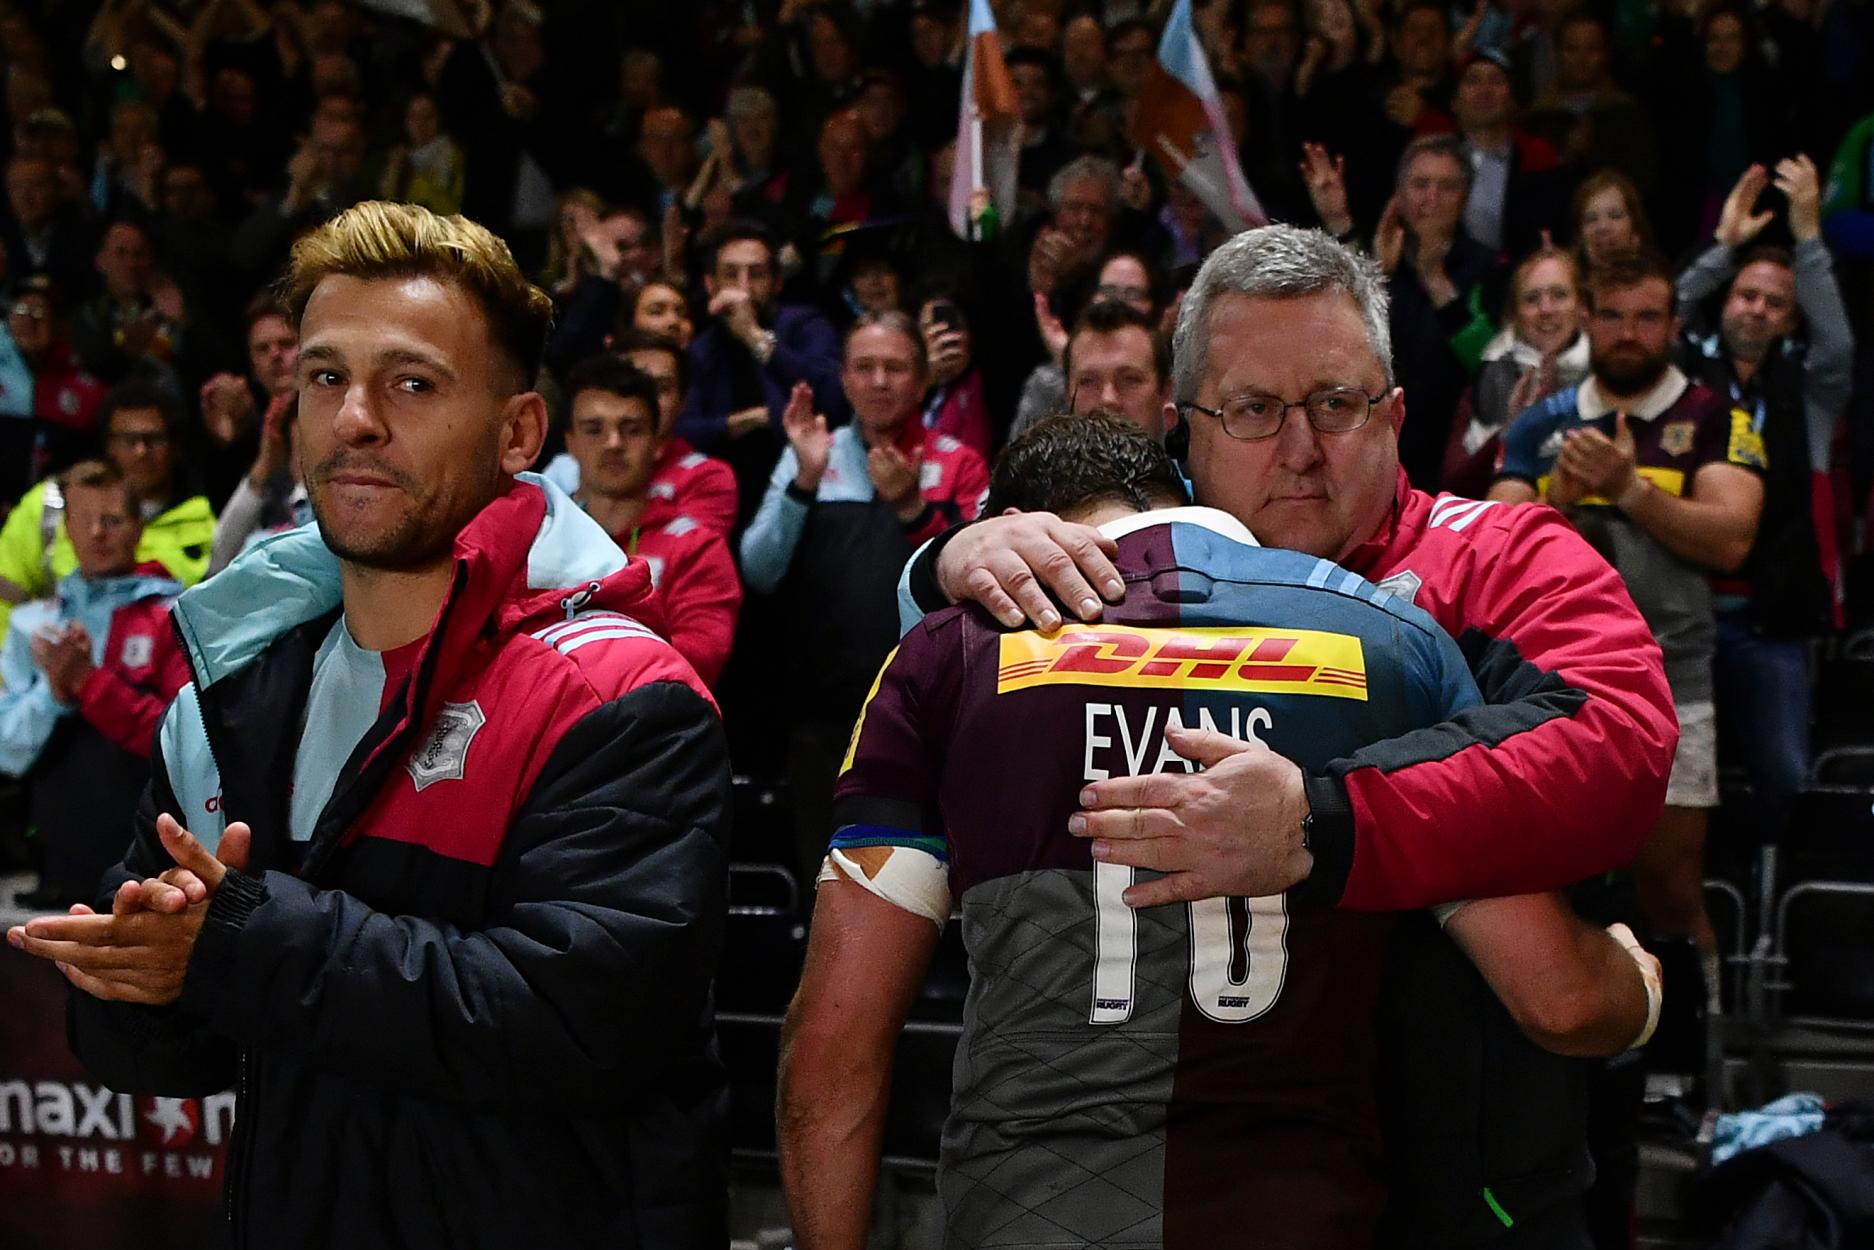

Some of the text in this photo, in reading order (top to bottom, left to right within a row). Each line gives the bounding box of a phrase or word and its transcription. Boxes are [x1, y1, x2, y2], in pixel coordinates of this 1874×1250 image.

[1047, 632, 1319, 683] DHL
[1217, 999, 1250, 1008] RUGBY
[58, 1146, 123, 1175] THE
[142, 1152, 213, 1180] FEW
